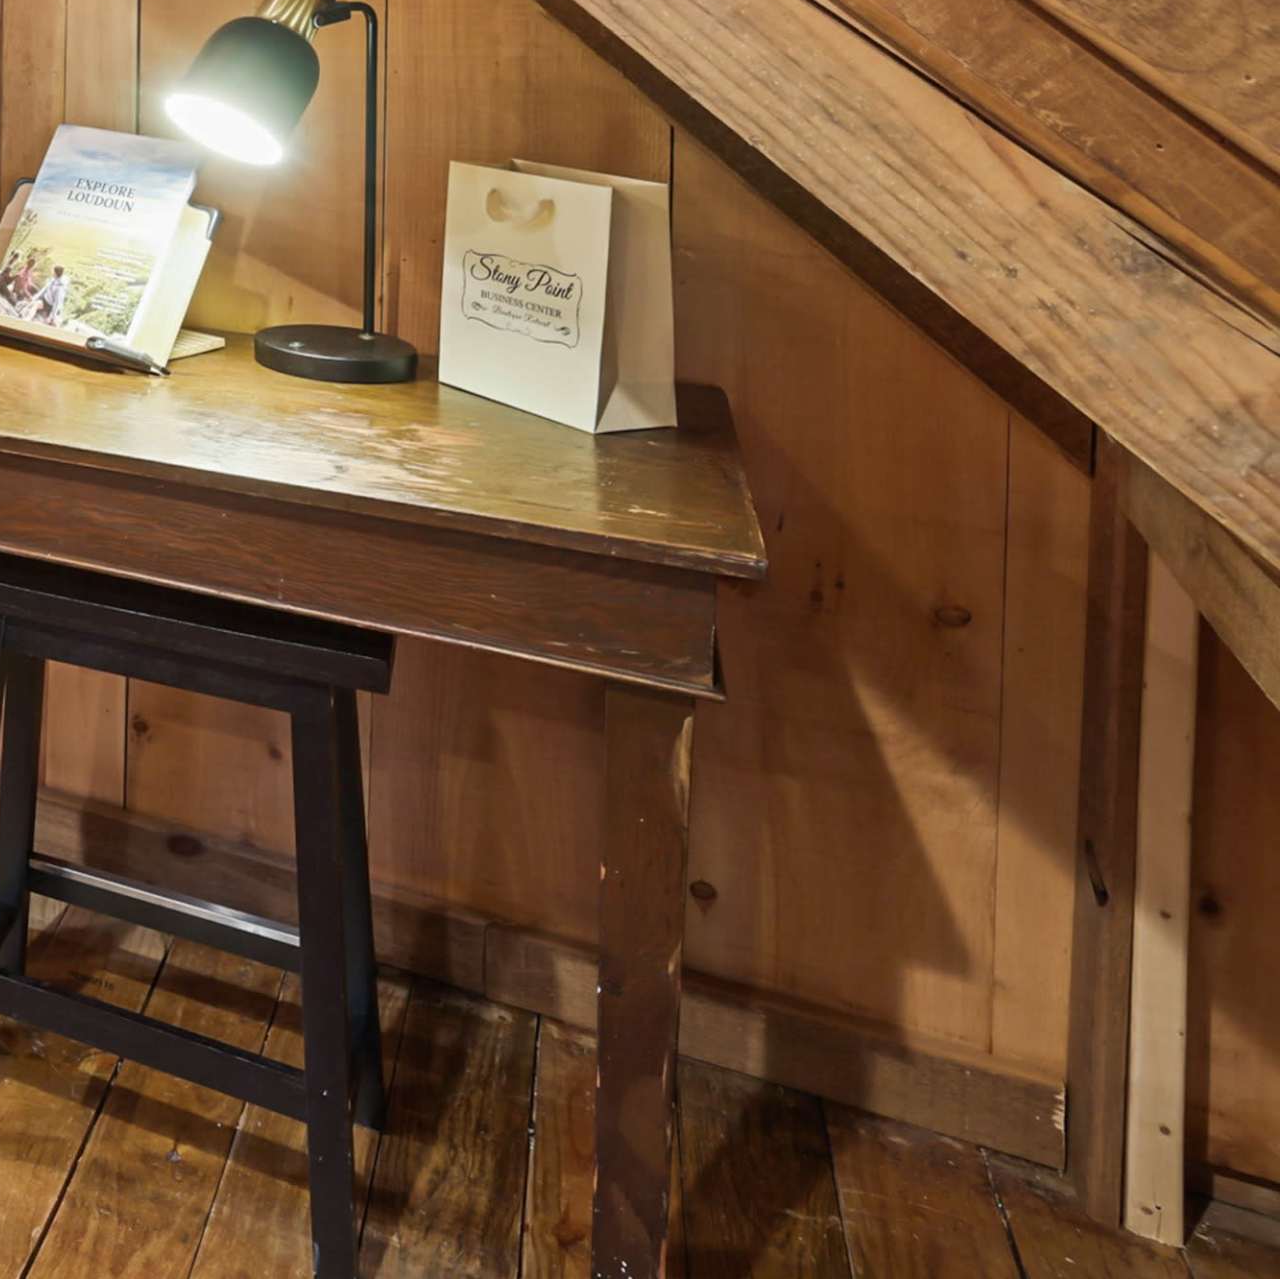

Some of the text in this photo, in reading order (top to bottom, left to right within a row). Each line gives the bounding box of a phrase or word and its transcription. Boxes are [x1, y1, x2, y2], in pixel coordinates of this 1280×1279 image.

[76, 177, 137, 199] EXPLORE
[67, 191, 136, 213] LOUDOUN
[470, 255, 574, 300] Stony Point
[480, 289, 562, 319] BUSINESS CENTER
